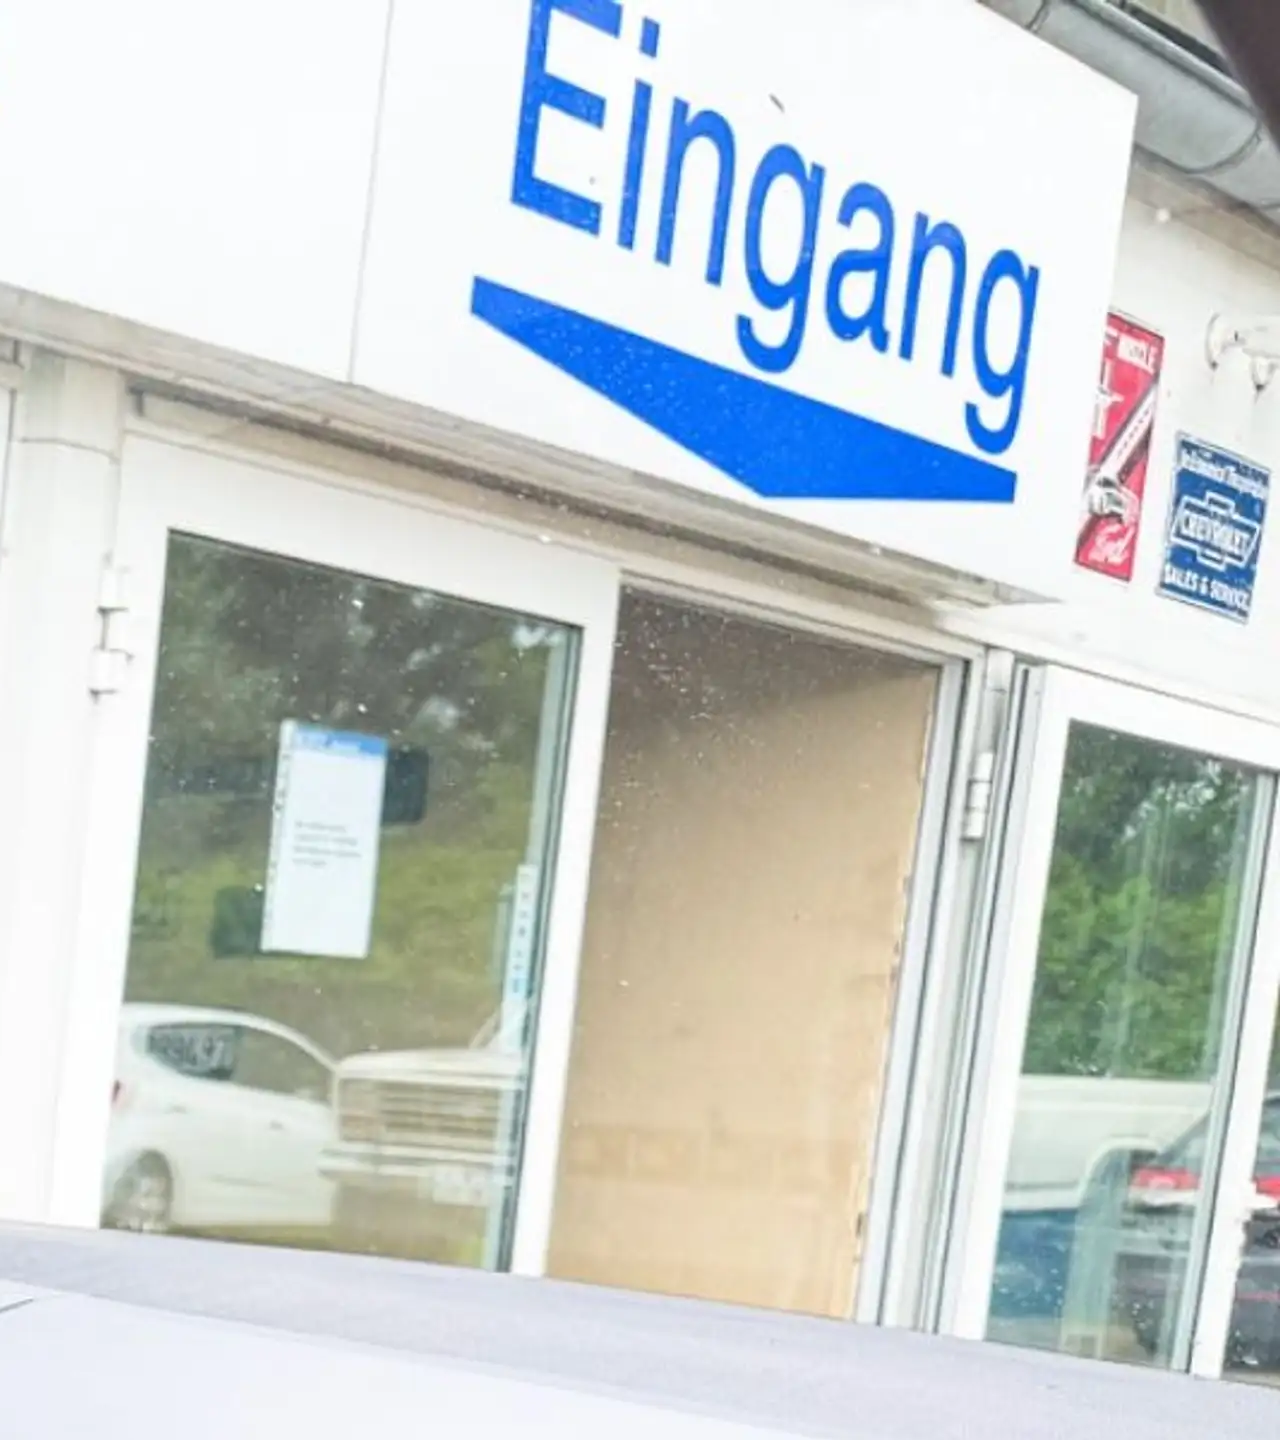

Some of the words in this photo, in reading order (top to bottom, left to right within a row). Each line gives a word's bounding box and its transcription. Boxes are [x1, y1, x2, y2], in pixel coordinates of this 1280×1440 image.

[511, 0, 1040, 455] Eingang
[1164, 564, 1198, 594] SALES
[1210, 577, 1249, 609] SERVICE
